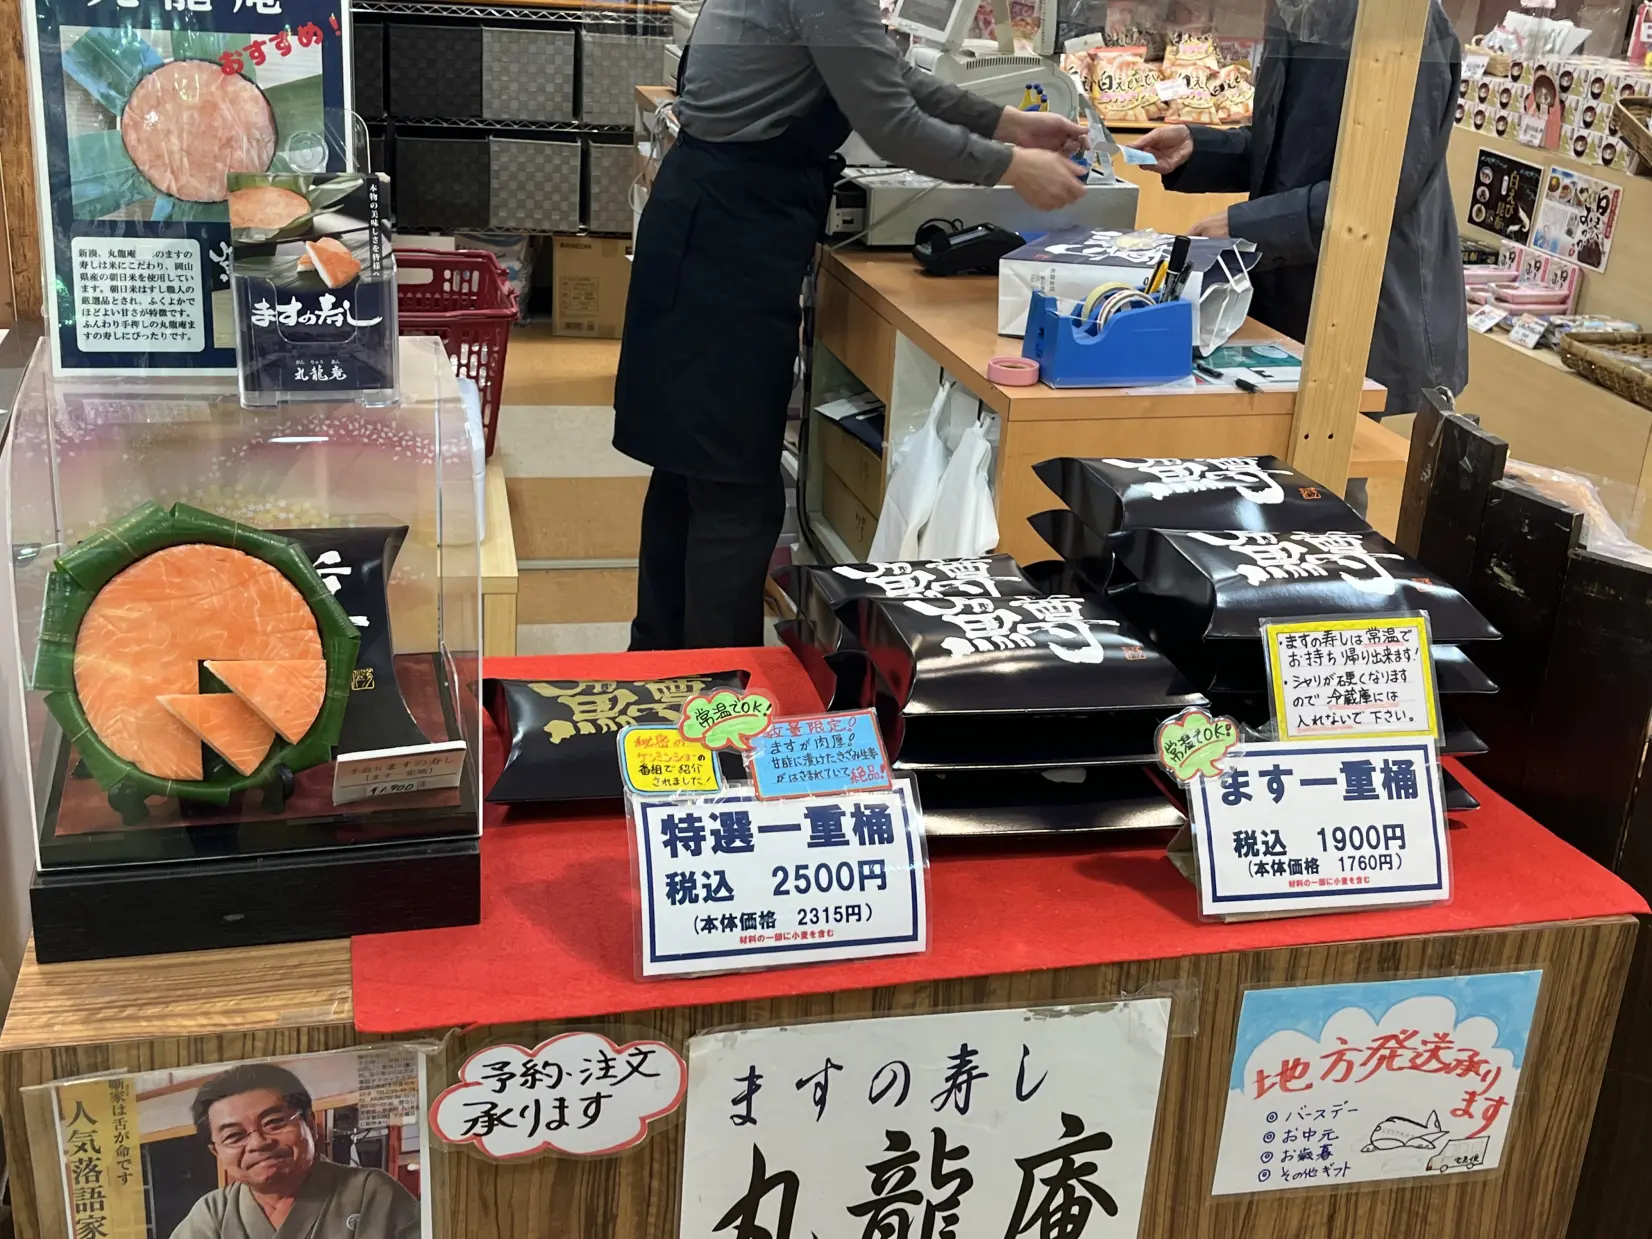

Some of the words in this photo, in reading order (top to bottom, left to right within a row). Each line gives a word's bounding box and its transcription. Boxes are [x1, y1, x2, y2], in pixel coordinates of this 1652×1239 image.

[218, 12, 341, 75] おすすめ!
[80, 272, 194, 283] 県産の朝日米を使用してい
[251, 292, 383, 328] ますの寿し
[1288, 646, 1420, 668] お持ち帰り出来ます!
[695, 700, 772, 729] 常温でOK!
[1297, 710, 1415, 728] 入れないで下さい。
[770, 733, 856, 754] ますが肉厚!
[1164, 723, 1232, 763] 常温でOK!
[638, 764, 702, 776] 番組で紹介
[1220, 758, 1420, 806] ます一重桶
[659, 802, 895, 859] 特選一重桶
[1232, 828, 1287, 858] 税込
[1317, 823, 1406, 852] 1900円
[665, 869, 735, 906] 税込
[772, 859, 887, 896] 2500円
[1248, 857, 1320, 878] (本体価格
[1338, 852, 1403, 872] 1760円)
[1288, 876, 1370, 888] 材料の一部に小麦を含む
[693, 910, 777, 935] (本体価格
[797, 903, 873, 926] 2315円)
[740, 929, 834, 944] 材料の一部に小麦を含む
[480, 1047, 661, 1093] 予約・注文
[1252, 1028, 1503, 1101] 地方発送承り
[729, 1042, 1049, 1127] ますの寿し
[460, 1092, 613, 1137] 承ります
[1448, 1090, 1510, 1139] ます
[1281, 1128, 1339, 1143] お中元
[1281, 1143, 1334, 1163] お歳暮
[66, 1101, 109, 1239] 人気落語家
